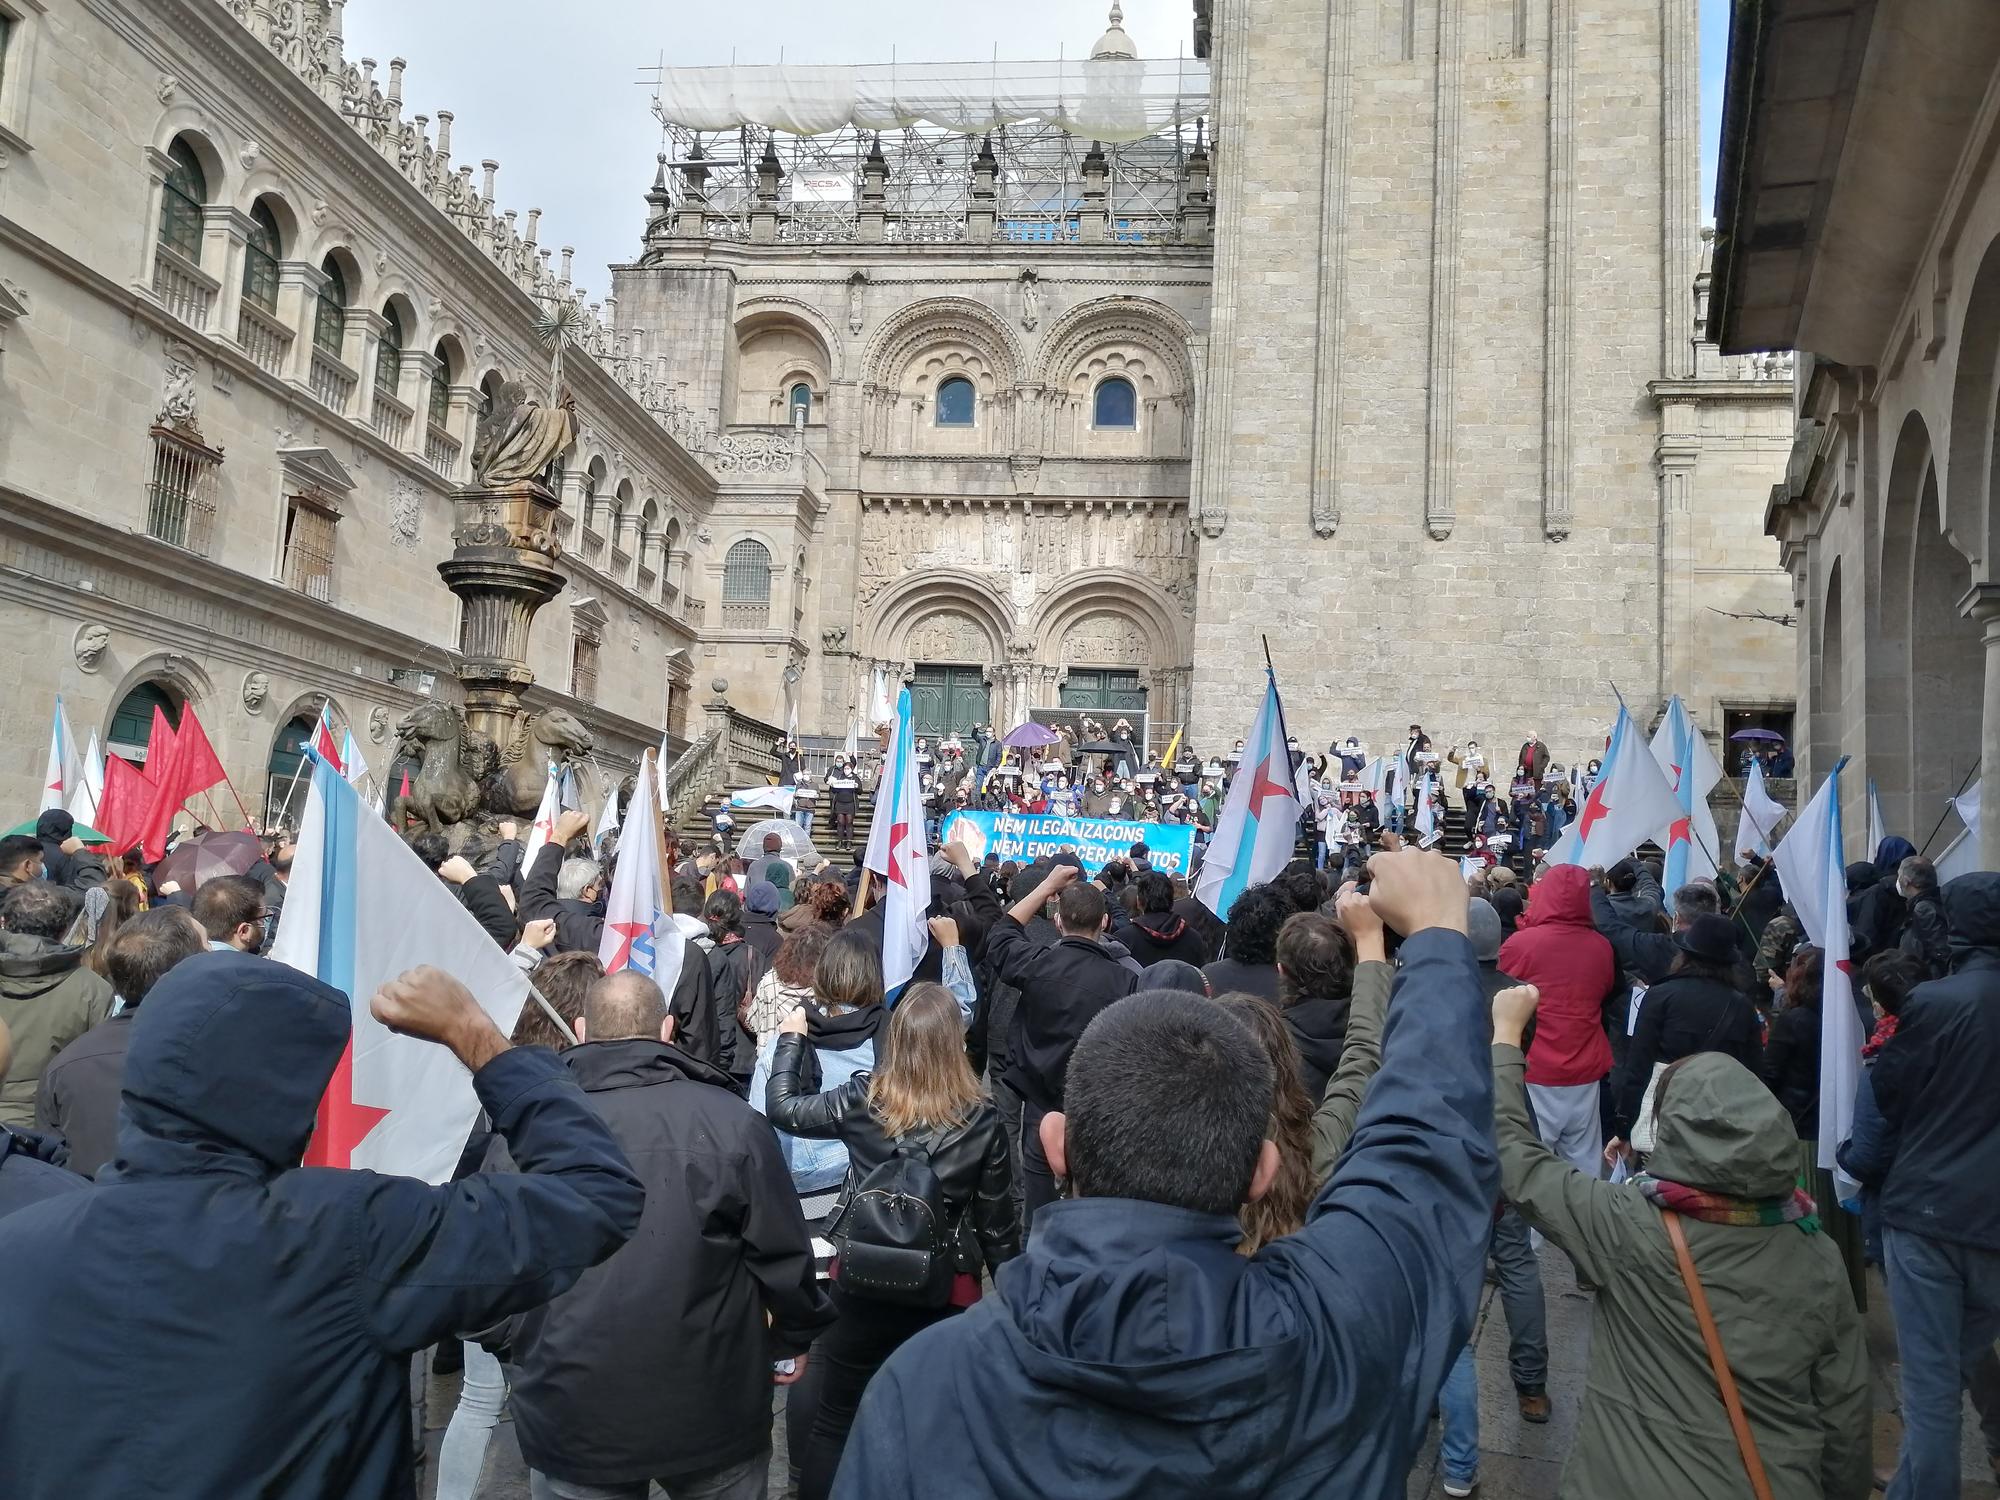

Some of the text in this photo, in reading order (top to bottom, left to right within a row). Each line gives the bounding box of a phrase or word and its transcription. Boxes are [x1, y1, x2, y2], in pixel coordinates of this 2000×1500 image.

[993, 816, 1145, 844] NEM ILEGALIZAÇONS
[991, 838, 1023, 856] NEM
[1026, 841, 1182, 869] ENCCERAMTOS
